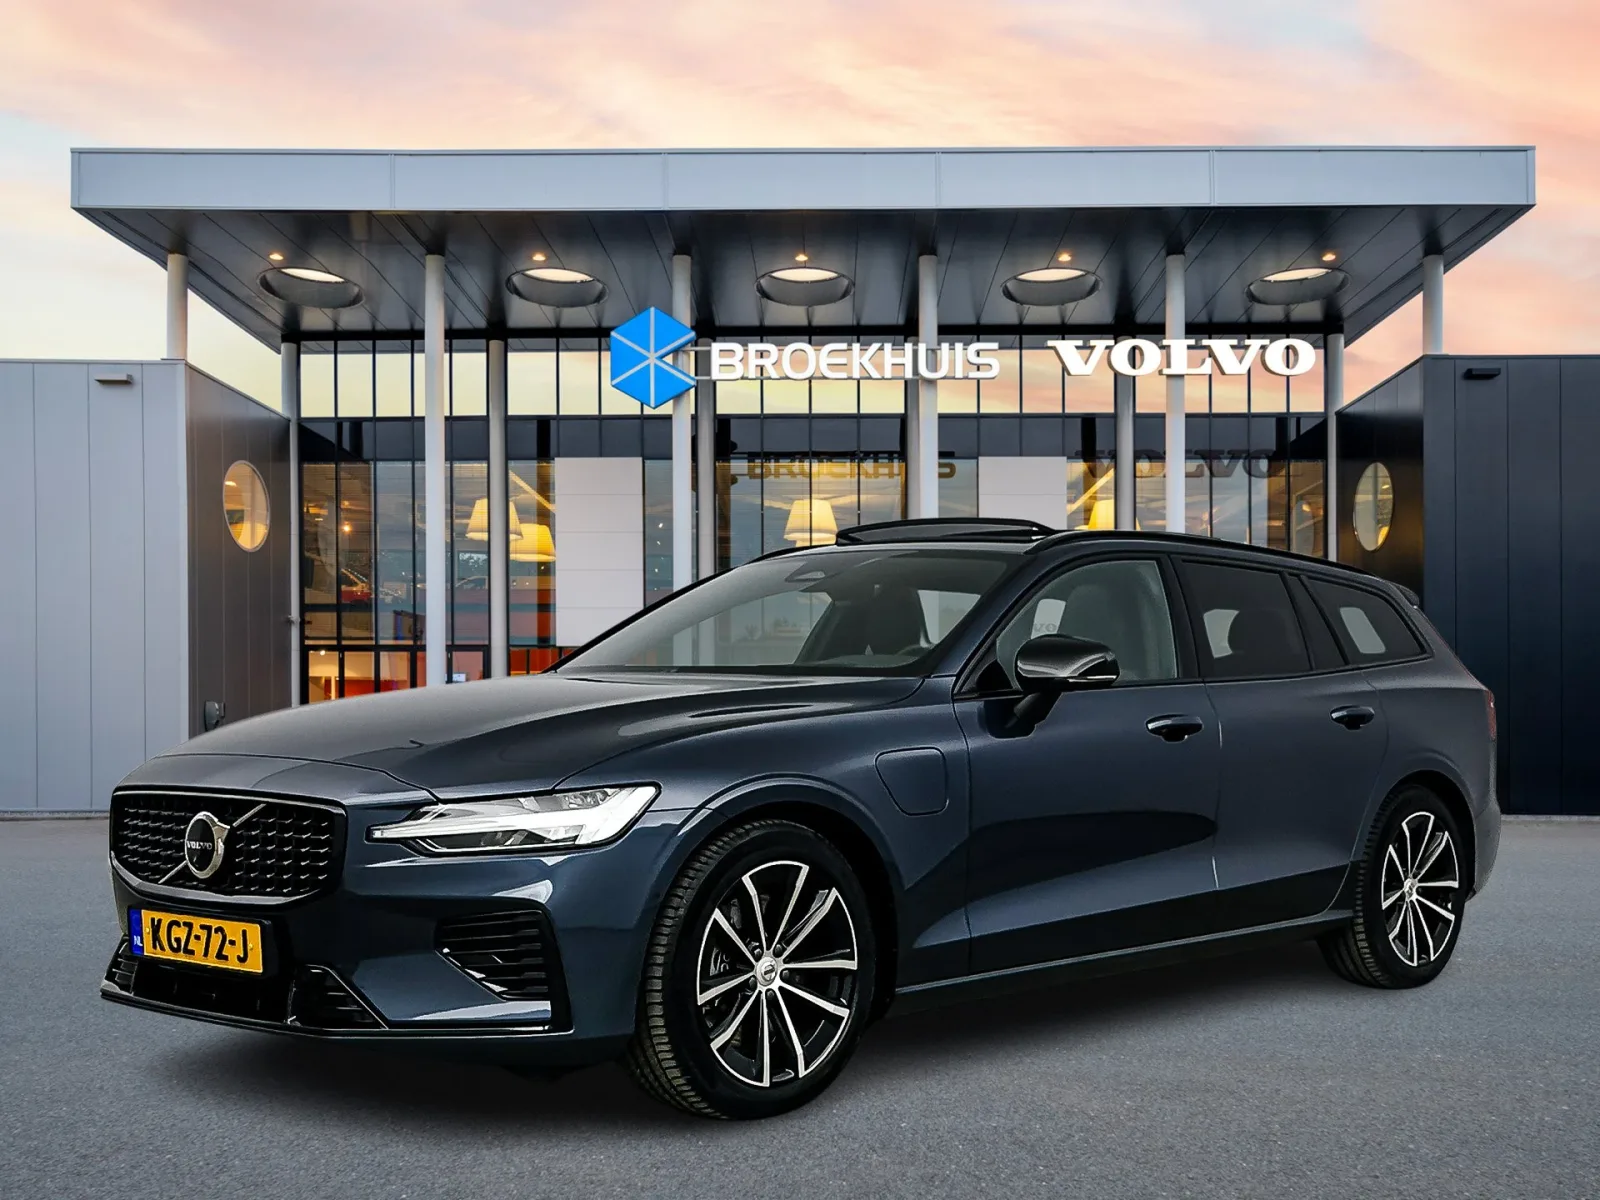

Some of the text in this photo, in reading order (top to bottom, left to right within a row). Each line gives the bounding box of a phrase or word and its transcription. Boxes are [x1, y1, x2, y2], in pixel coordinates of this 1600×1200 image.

[710, 342, 1000, 380] BROEKHUIS
[1045, 338, 1316, 376] VOLVO
[186, 840, 213, 850] VOLVO
[133, 935, 143, 947] NL
[150, 917, 249, 964] KGZ-72-J
